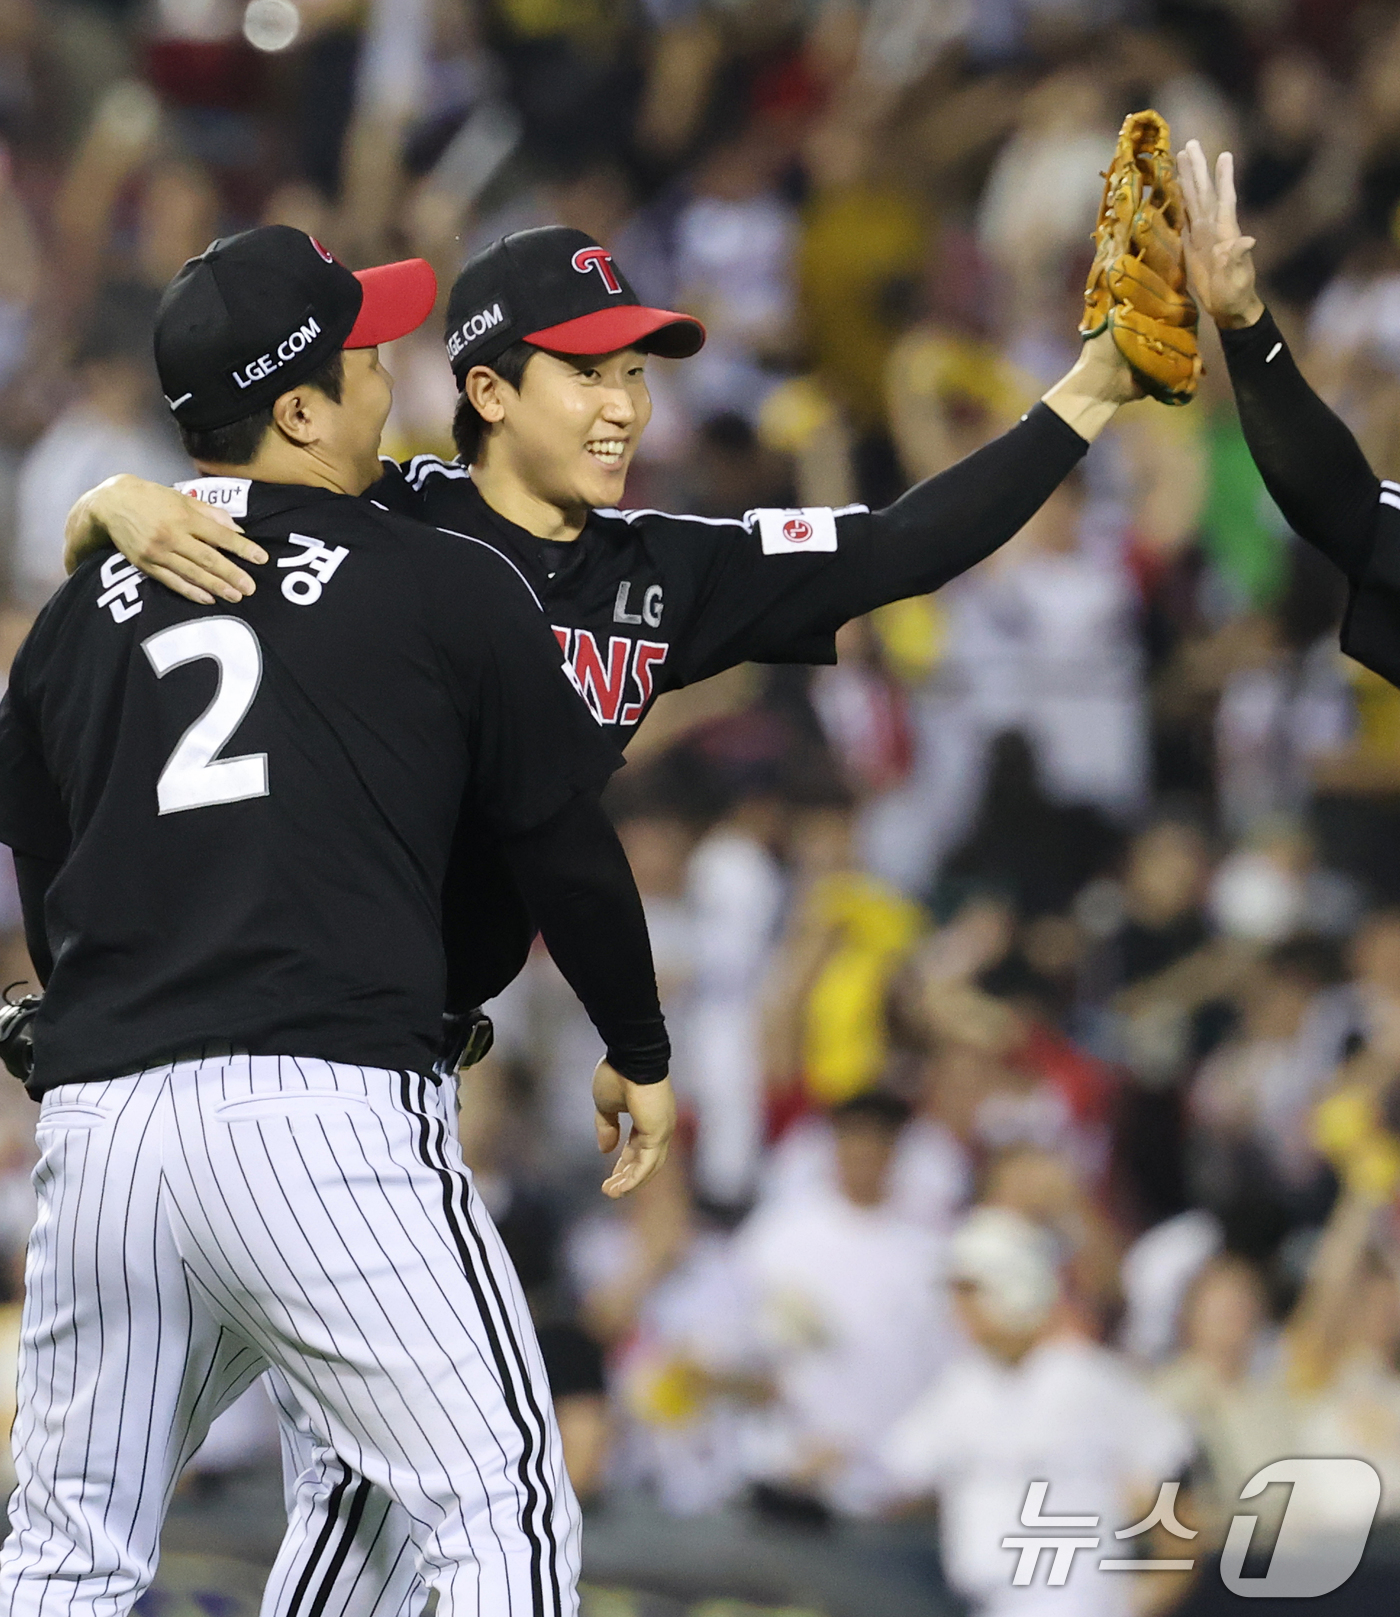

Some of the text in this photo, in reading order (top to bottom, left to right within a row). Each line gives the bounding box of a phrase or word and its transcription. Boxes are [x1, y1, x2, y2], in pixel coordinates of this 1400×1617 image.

[232, 316, 321, 389] LGE.COM
[446, 303, 503, 361] LGE.COM
[613, 581, 664, 628] LG
[140, 614, 270, 816] 2
